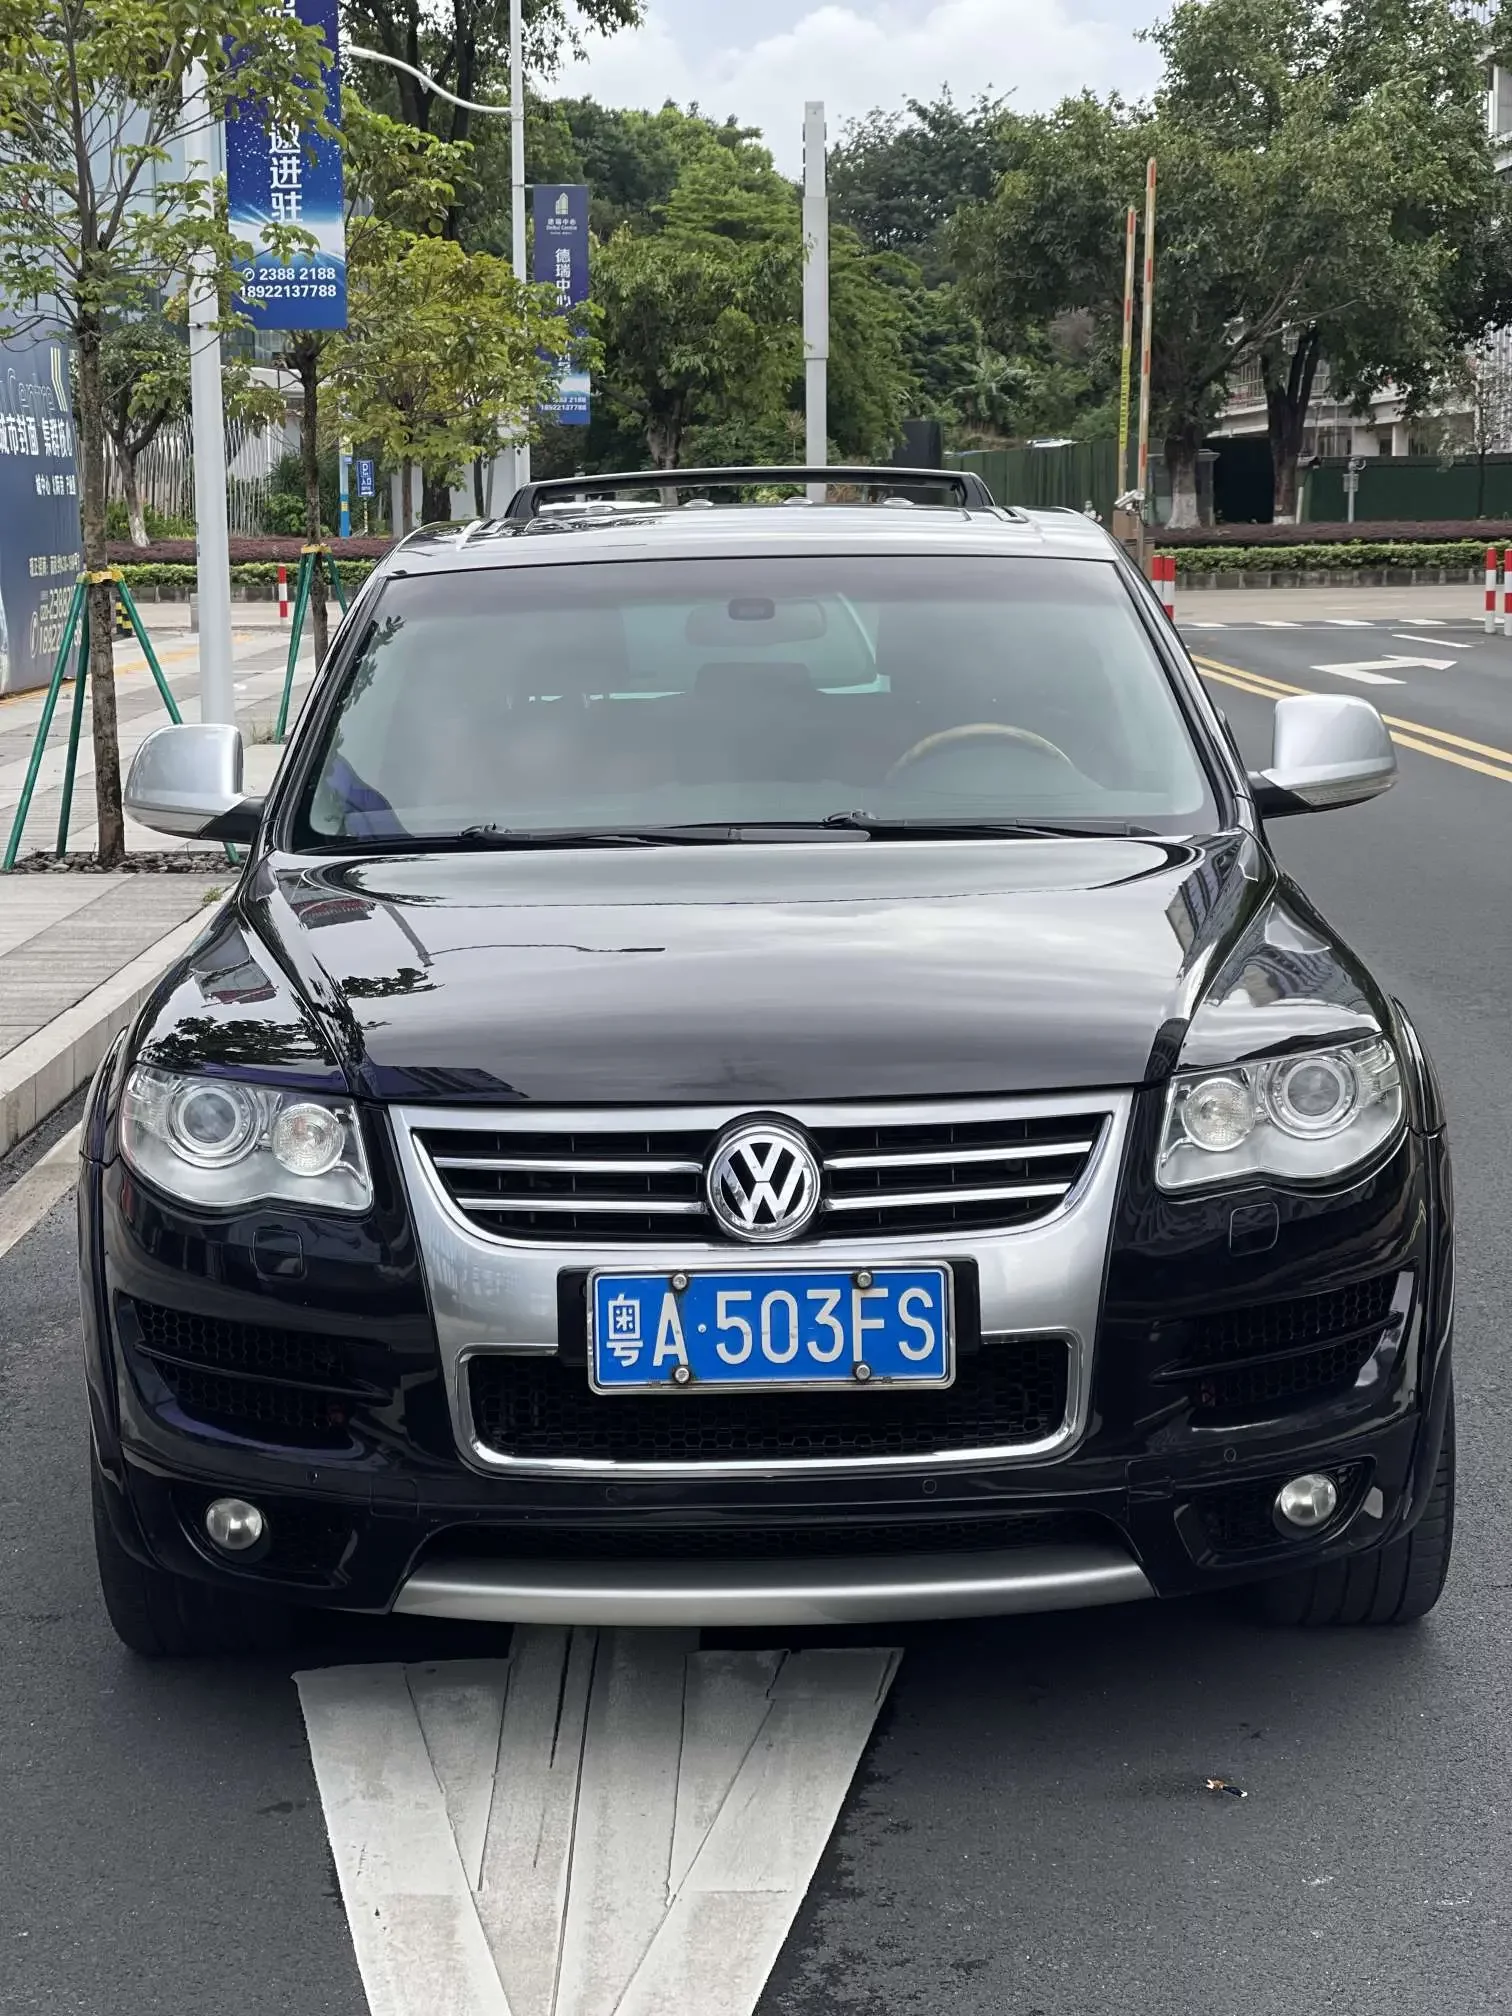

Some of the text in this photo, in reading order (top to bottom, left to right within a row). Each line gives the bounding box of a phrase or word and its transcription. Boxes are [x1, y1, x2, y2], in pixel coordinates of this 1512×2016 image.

[259, 267, 336, 280] 2388 2188
[555, 248, 571, 307] 德瑞中心
[240, 284, 337, 298] 18922137788
